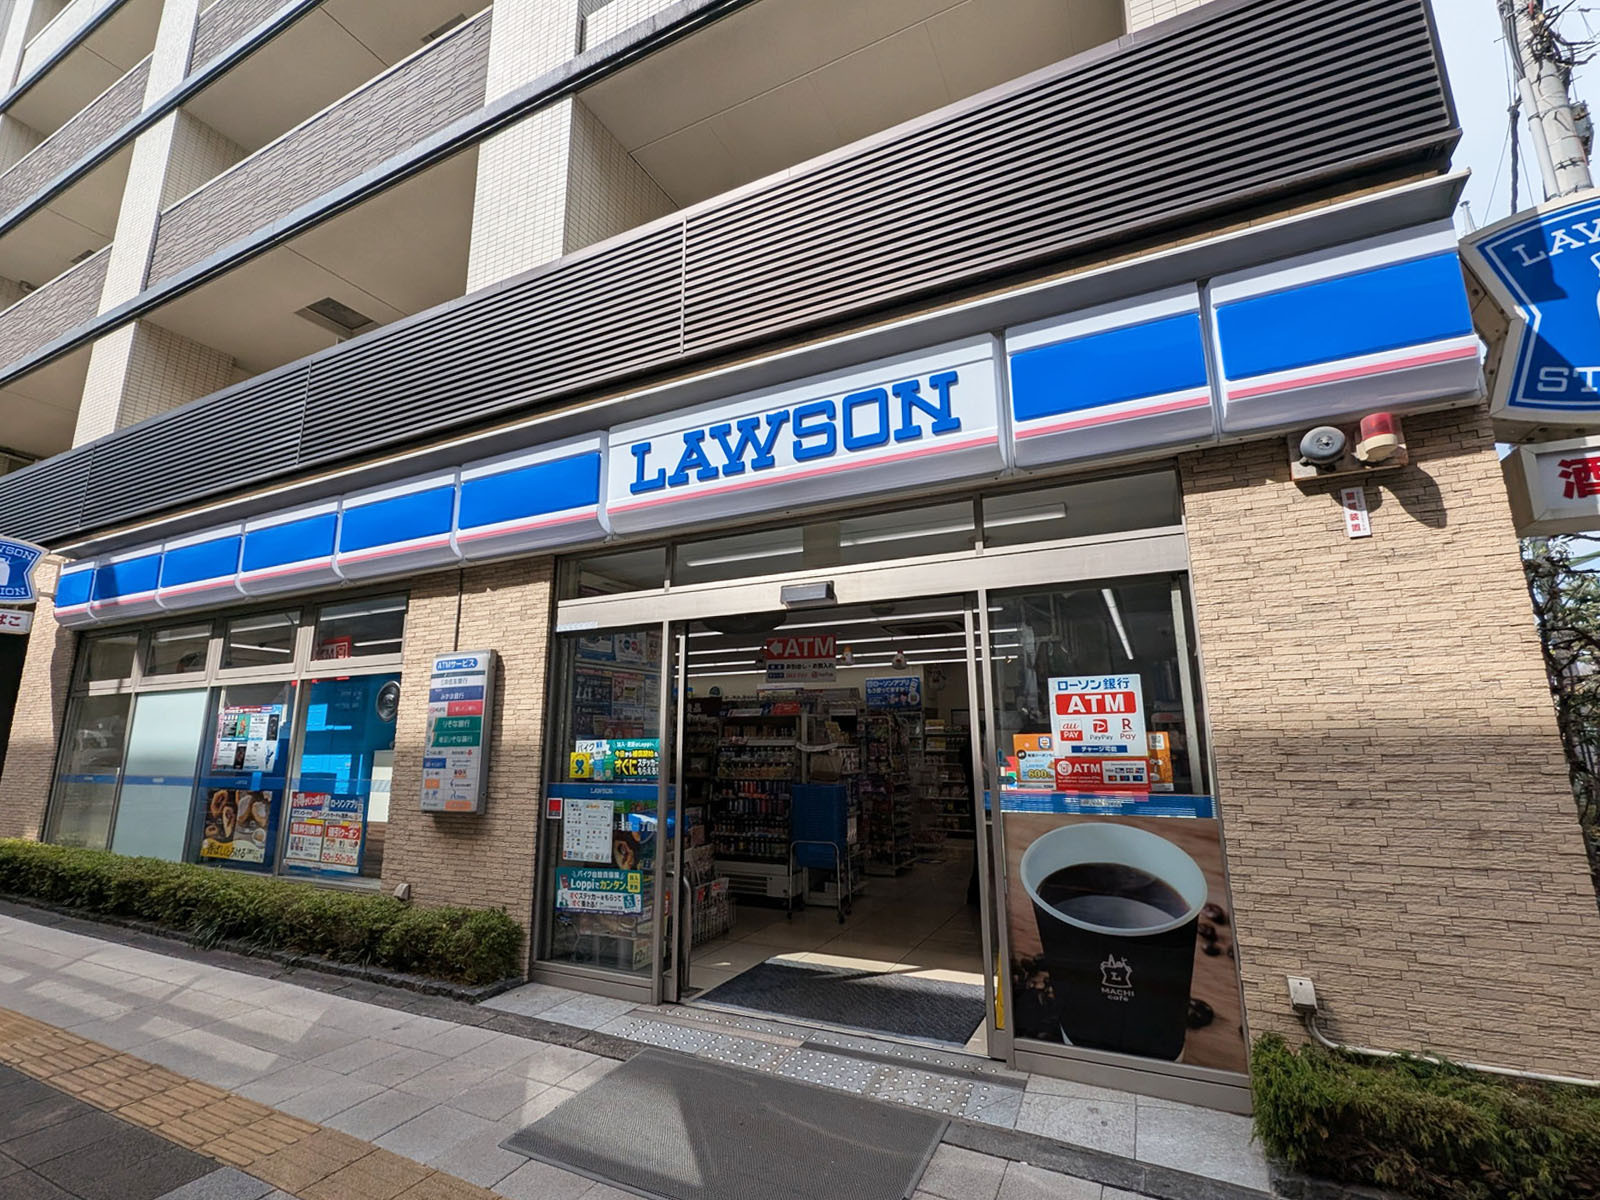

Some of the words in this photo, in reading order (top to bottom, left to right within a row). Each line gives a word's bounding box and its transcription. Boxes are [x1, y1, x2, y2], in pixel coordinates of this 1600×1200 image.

[1537, 366, 1600, 393] ST
[630, 370, 961, 494] LAWSON
[784, 637, 834, 657] ATM
[437, 659, 476, 669] ATMサービス
[1057, 677, 1130, 691] ローソン銀行
[1067, 693, 1126, 713] ATM
[442, 719, 471, 729] りそな銀行
[1122, 718, 1132, 730] R
[1120, 732, 1136, 741] Pay
[1081, 745, 1117, 753] チャージ可能
[614, 759, 637, 776] すぐに
[637, 759, 659, 767] ステッカー
[1073, 763, 1101, 773] ATM
[1110, 971, 1121, 981] L
[1101, 987, 1134, 997] MACHI
